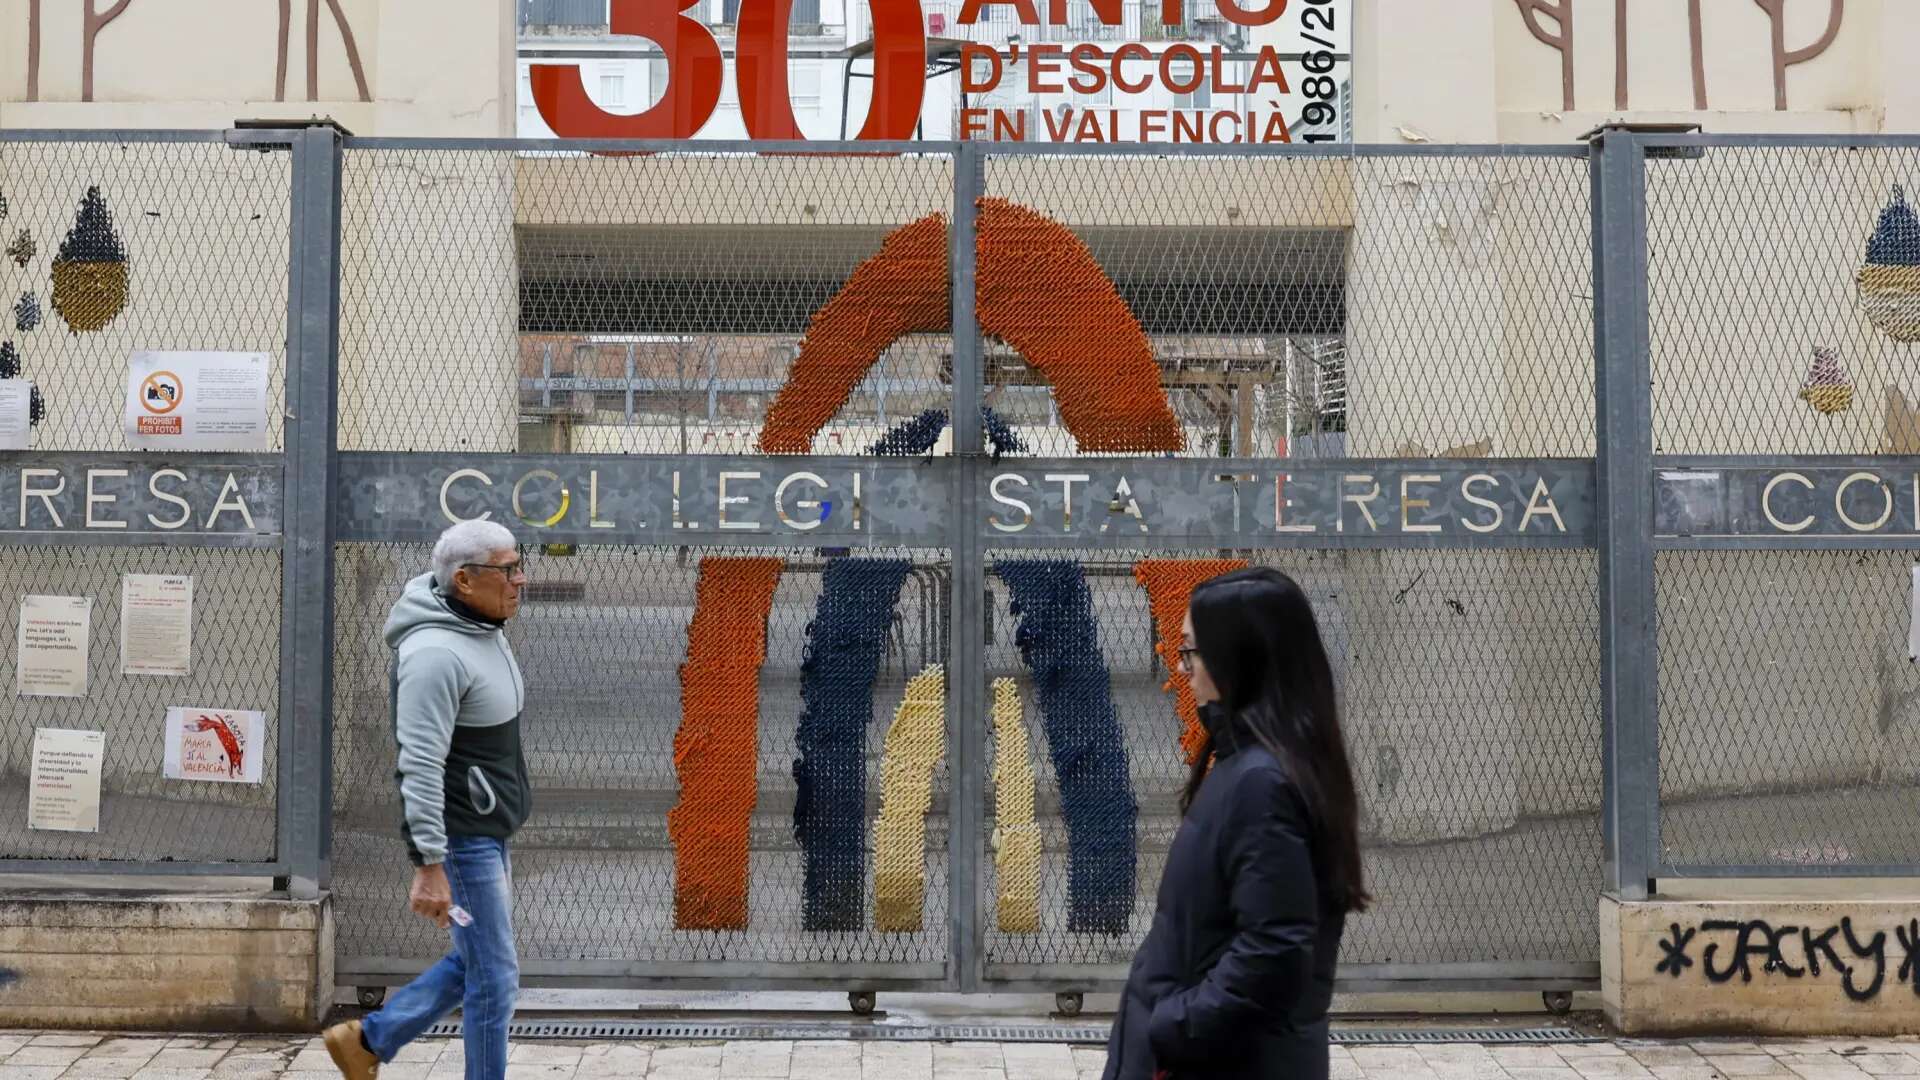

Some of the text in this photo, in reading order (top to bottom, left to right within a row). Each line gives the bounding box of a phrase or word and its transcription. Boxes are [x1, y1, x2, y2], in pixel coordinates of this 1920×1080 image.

[959, 43, 1291, 95] D'ESCOLA
[959, 100, 1293, 144] EN VALENCIÀ
[139, 425, 180, 434] FER FOTOS
[142, 417, 177, 425] PROHIBIT
[1214, 473, 1567, 533] TERESA
